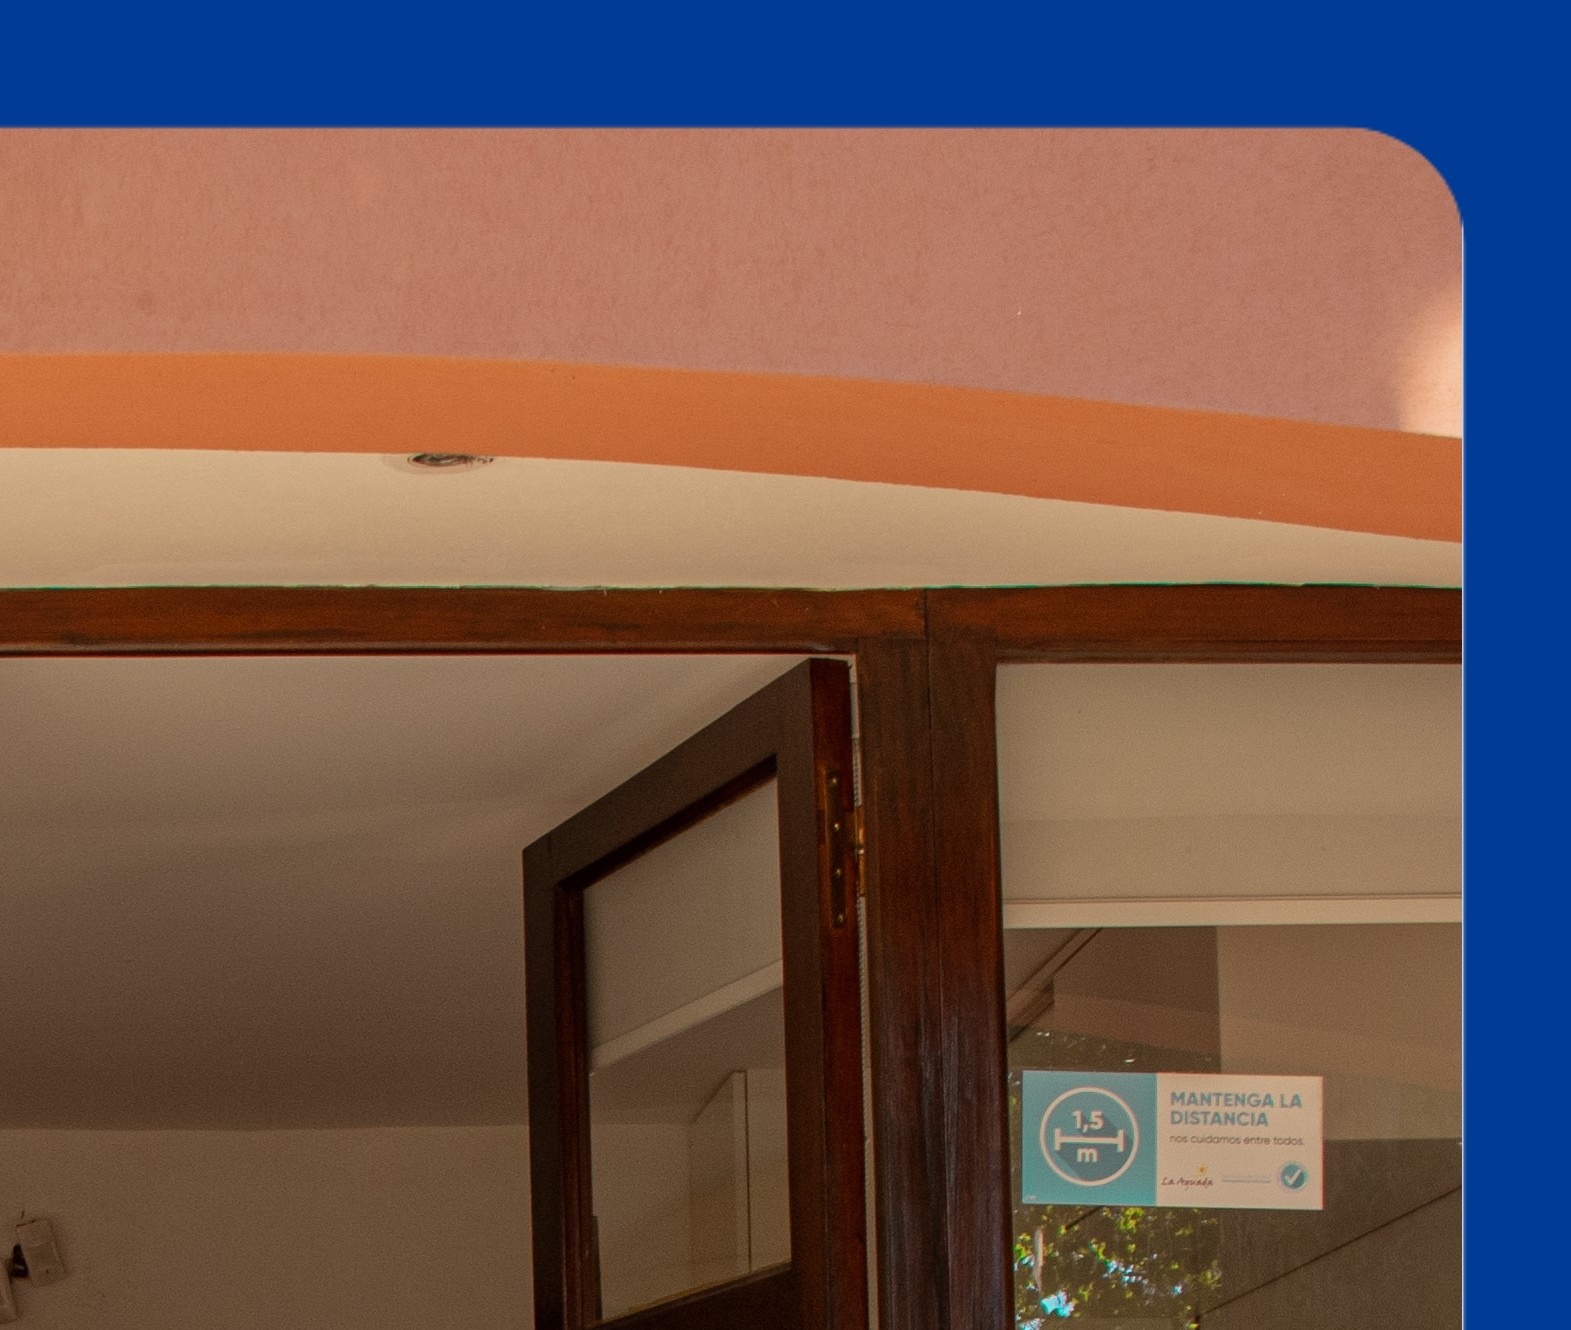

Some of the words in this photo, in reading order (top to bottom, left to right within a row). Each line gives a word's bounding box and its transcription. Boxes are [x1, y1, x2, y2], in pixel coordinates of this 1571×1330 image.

[1170, 1091, 1274, 1108] MANTENGA
[1280, 1093, 1302, 1109] LA
[1073, 1110, 1104, 1133] 1,5
[1170, 1110, 1269, 1126] DISTANCIA
[1169, 1135, 1188, 1144] nos
[1190, 1134, 1241, 1145] cuidamos
[1243, 1136, 1270, 1146] entre
[1077, 1148, 1099, 1163] m
